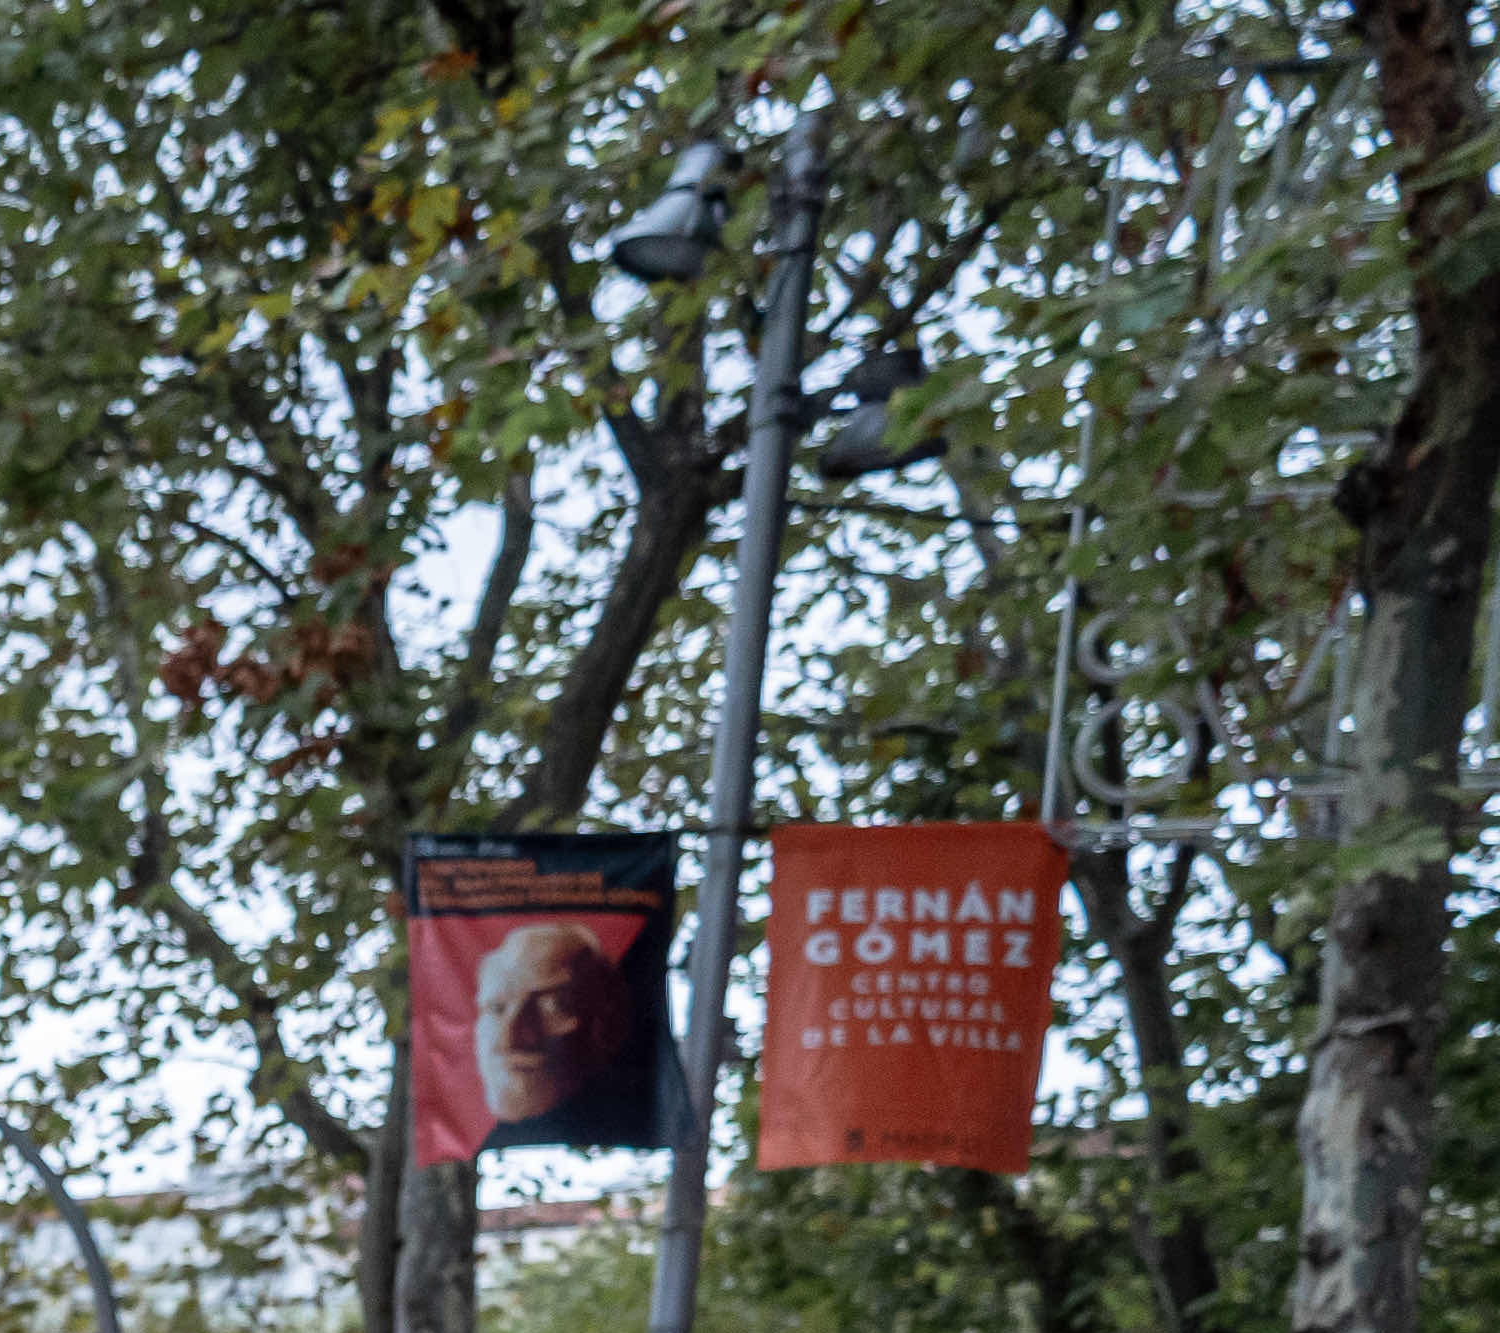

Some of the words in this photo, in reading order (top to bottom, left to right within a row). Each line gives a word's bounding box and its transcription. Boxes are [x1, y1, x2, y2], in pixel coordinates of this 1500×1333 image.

[805, 881, 1036, 924] FERNÁN
[804, 921, 1033, 967] GÓMEZ
[850, 971, 991, 995] CENTRO
[828, 998, 1007, 1023] CULTURAL
[801, 1026, 848, 1049] DE
[867, 1023, 912, 1046] LA
[927, 1025, 1022, 1050] VILLA
